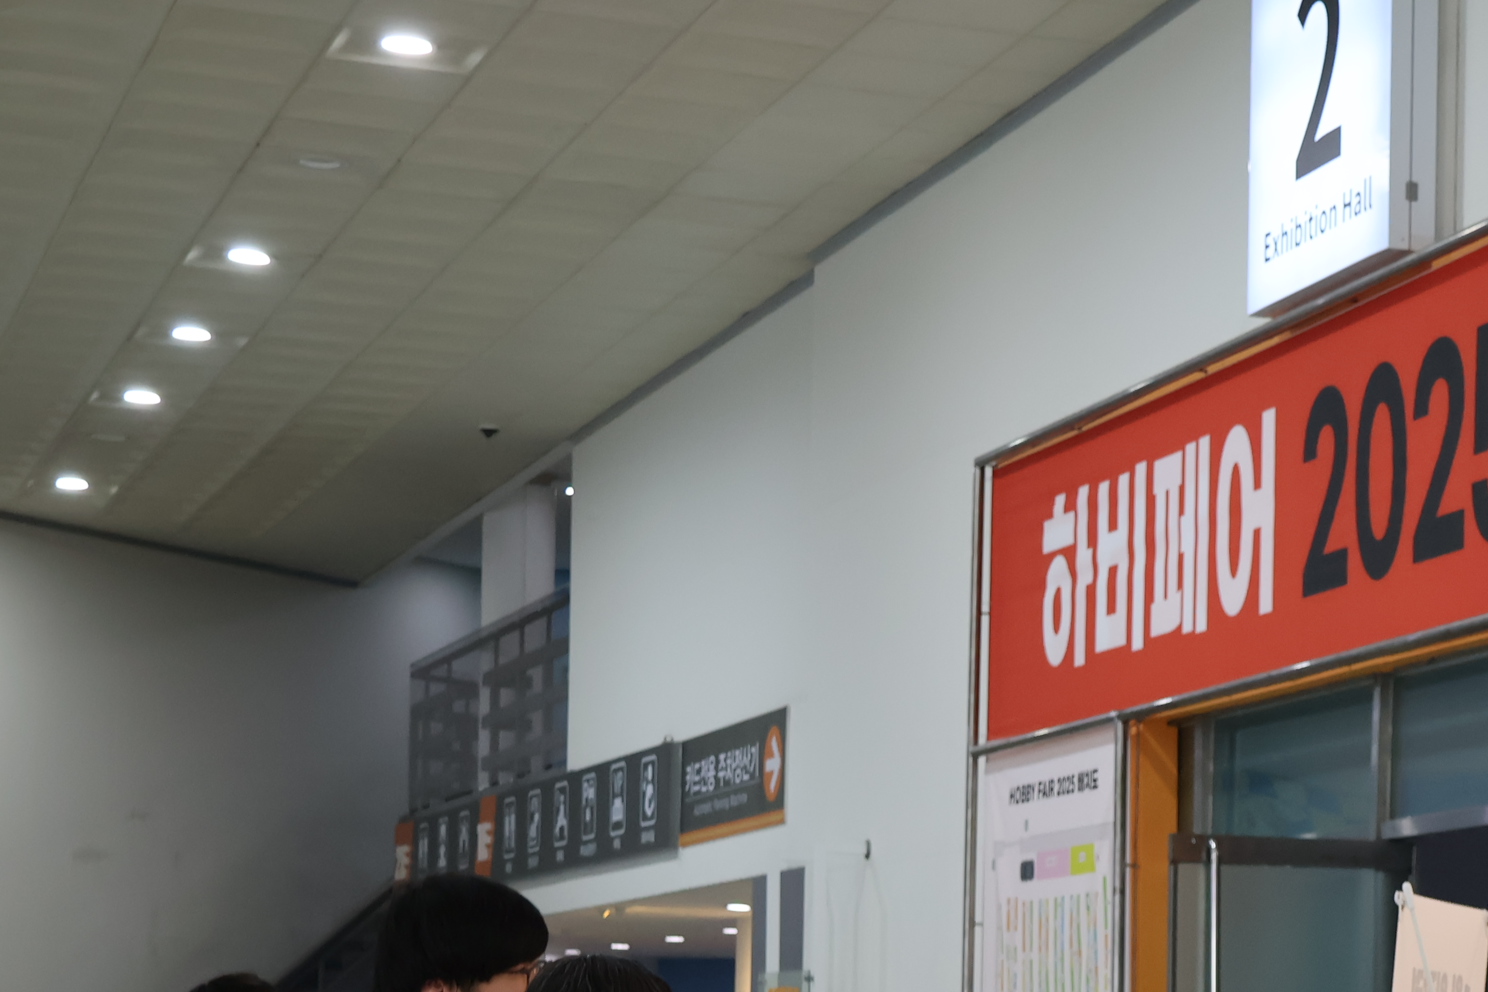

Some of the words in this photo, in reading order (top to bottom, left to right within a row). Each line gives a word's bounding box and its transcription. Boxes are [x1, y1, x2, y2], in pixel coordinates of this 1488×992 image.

[1295, 0, 1342, 181] 2
[1263, 197, 1338, 263] Exhibition
[1341, 176, 1374, 225] Hall
[1042, 406, 1277, 668] 하비페어
[1009, 783, 1035, 804] HOBBY
[1038, 778, 1055, 799] FAIR
[1057, 774, 1075, 796] 2025
